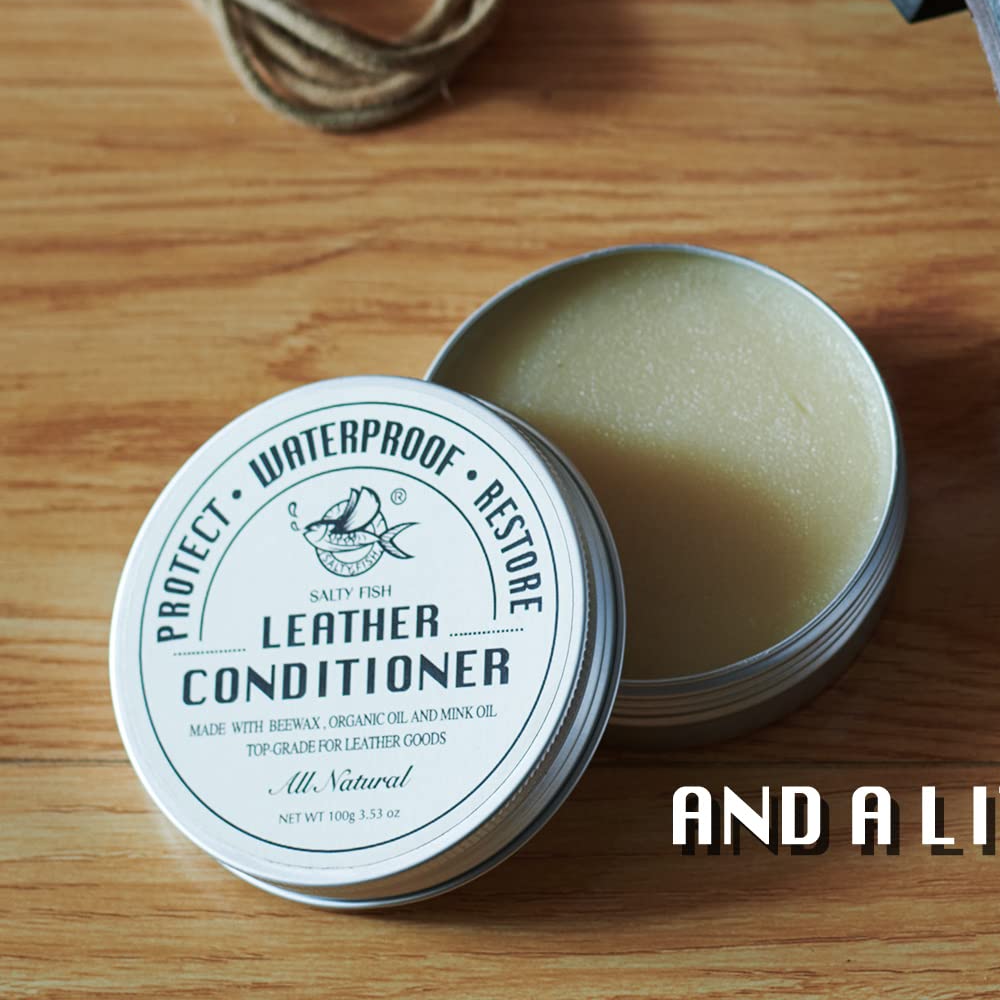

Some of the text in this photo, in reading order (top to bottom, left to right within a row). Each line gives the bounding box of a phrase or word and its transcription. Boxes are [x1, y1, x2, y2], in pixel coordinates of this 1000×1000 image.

[157, 418, 543, 644] PROTECT WATERPROOF RESTORE
[309, 584, 392, 603] SALTY FISH
[262, 604, 440, 650] LEATHER
[182, 646, 511, 706] CONDITIONER
[189, 722, 227, 737] MADE
[231, 719, 264, 734] WITH
[328, 711, 385, 729] ORGANIC
[387, 711, 408, 725] OIL
[410, 708, 438, 723] AND
[440, 705, 474, 721] MINK
[476, 704, 498, 718] OIL
[246, 731, 447, 757] TOP-GRADE FOR LEATHER GOODS
[268, 764, 414, 796] All Natural
[279, 808, 401, 825] NET WT 100g 3.53 oz
